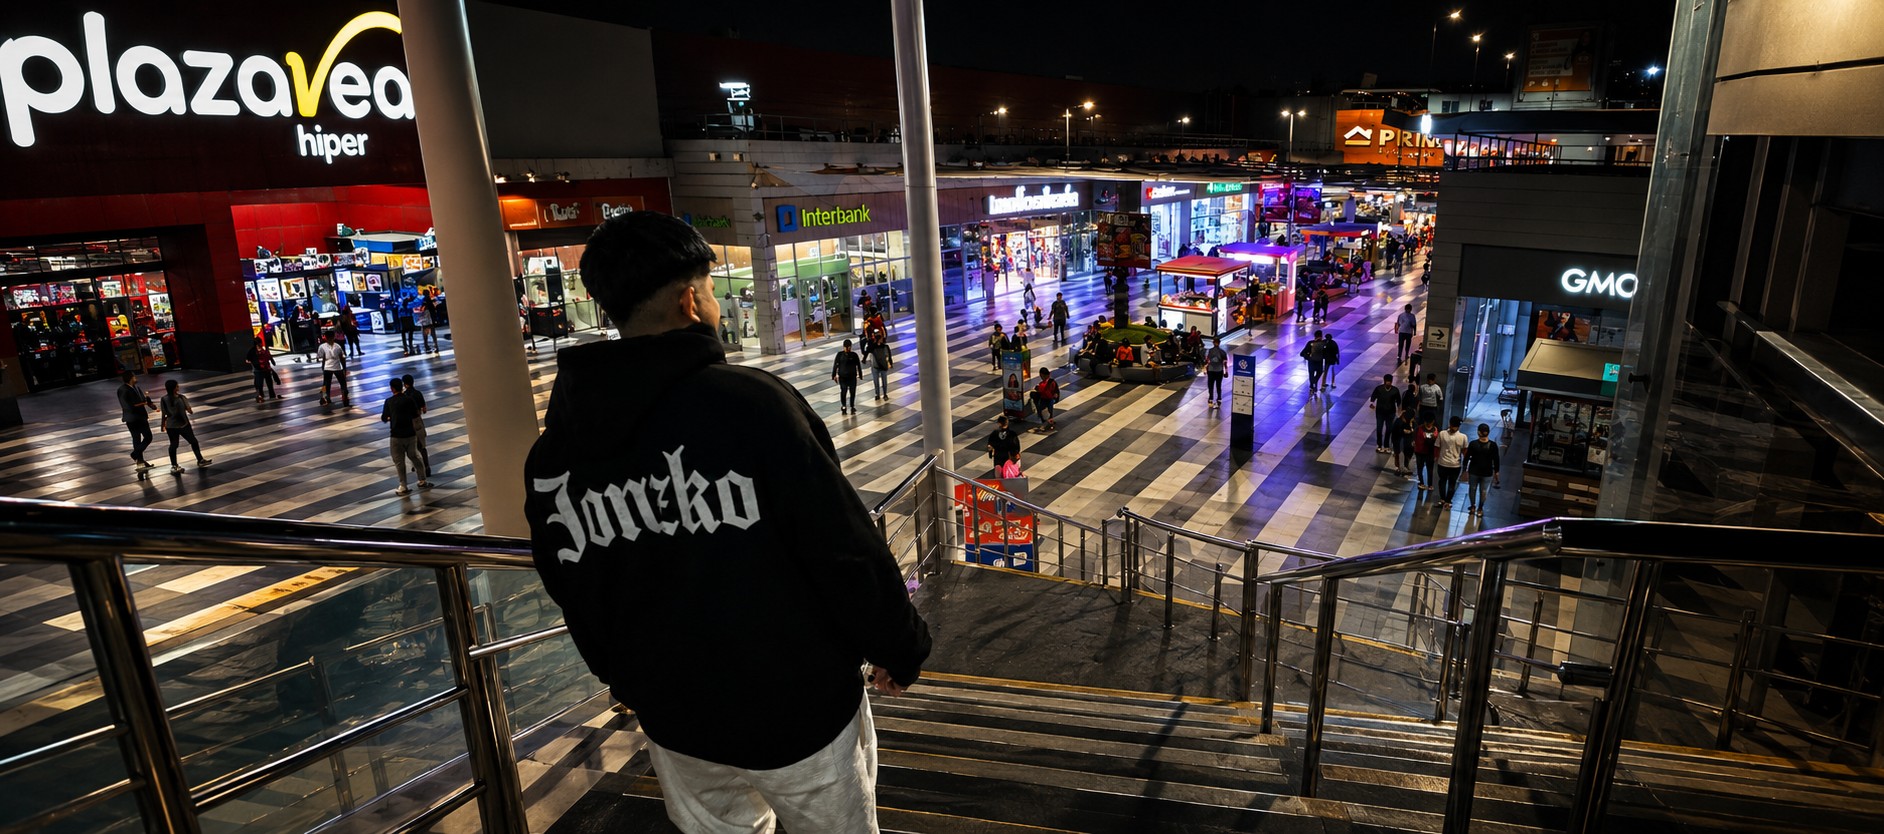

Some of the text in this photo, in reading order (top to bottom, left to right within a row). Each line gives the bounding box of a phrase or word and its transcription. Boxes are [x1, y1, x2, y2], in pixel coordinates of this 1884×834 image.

[297, 125, 369, 164] hiper
[801, 204, 872, 228] Interbank
[1561, 268, 1639, 299] GMO
